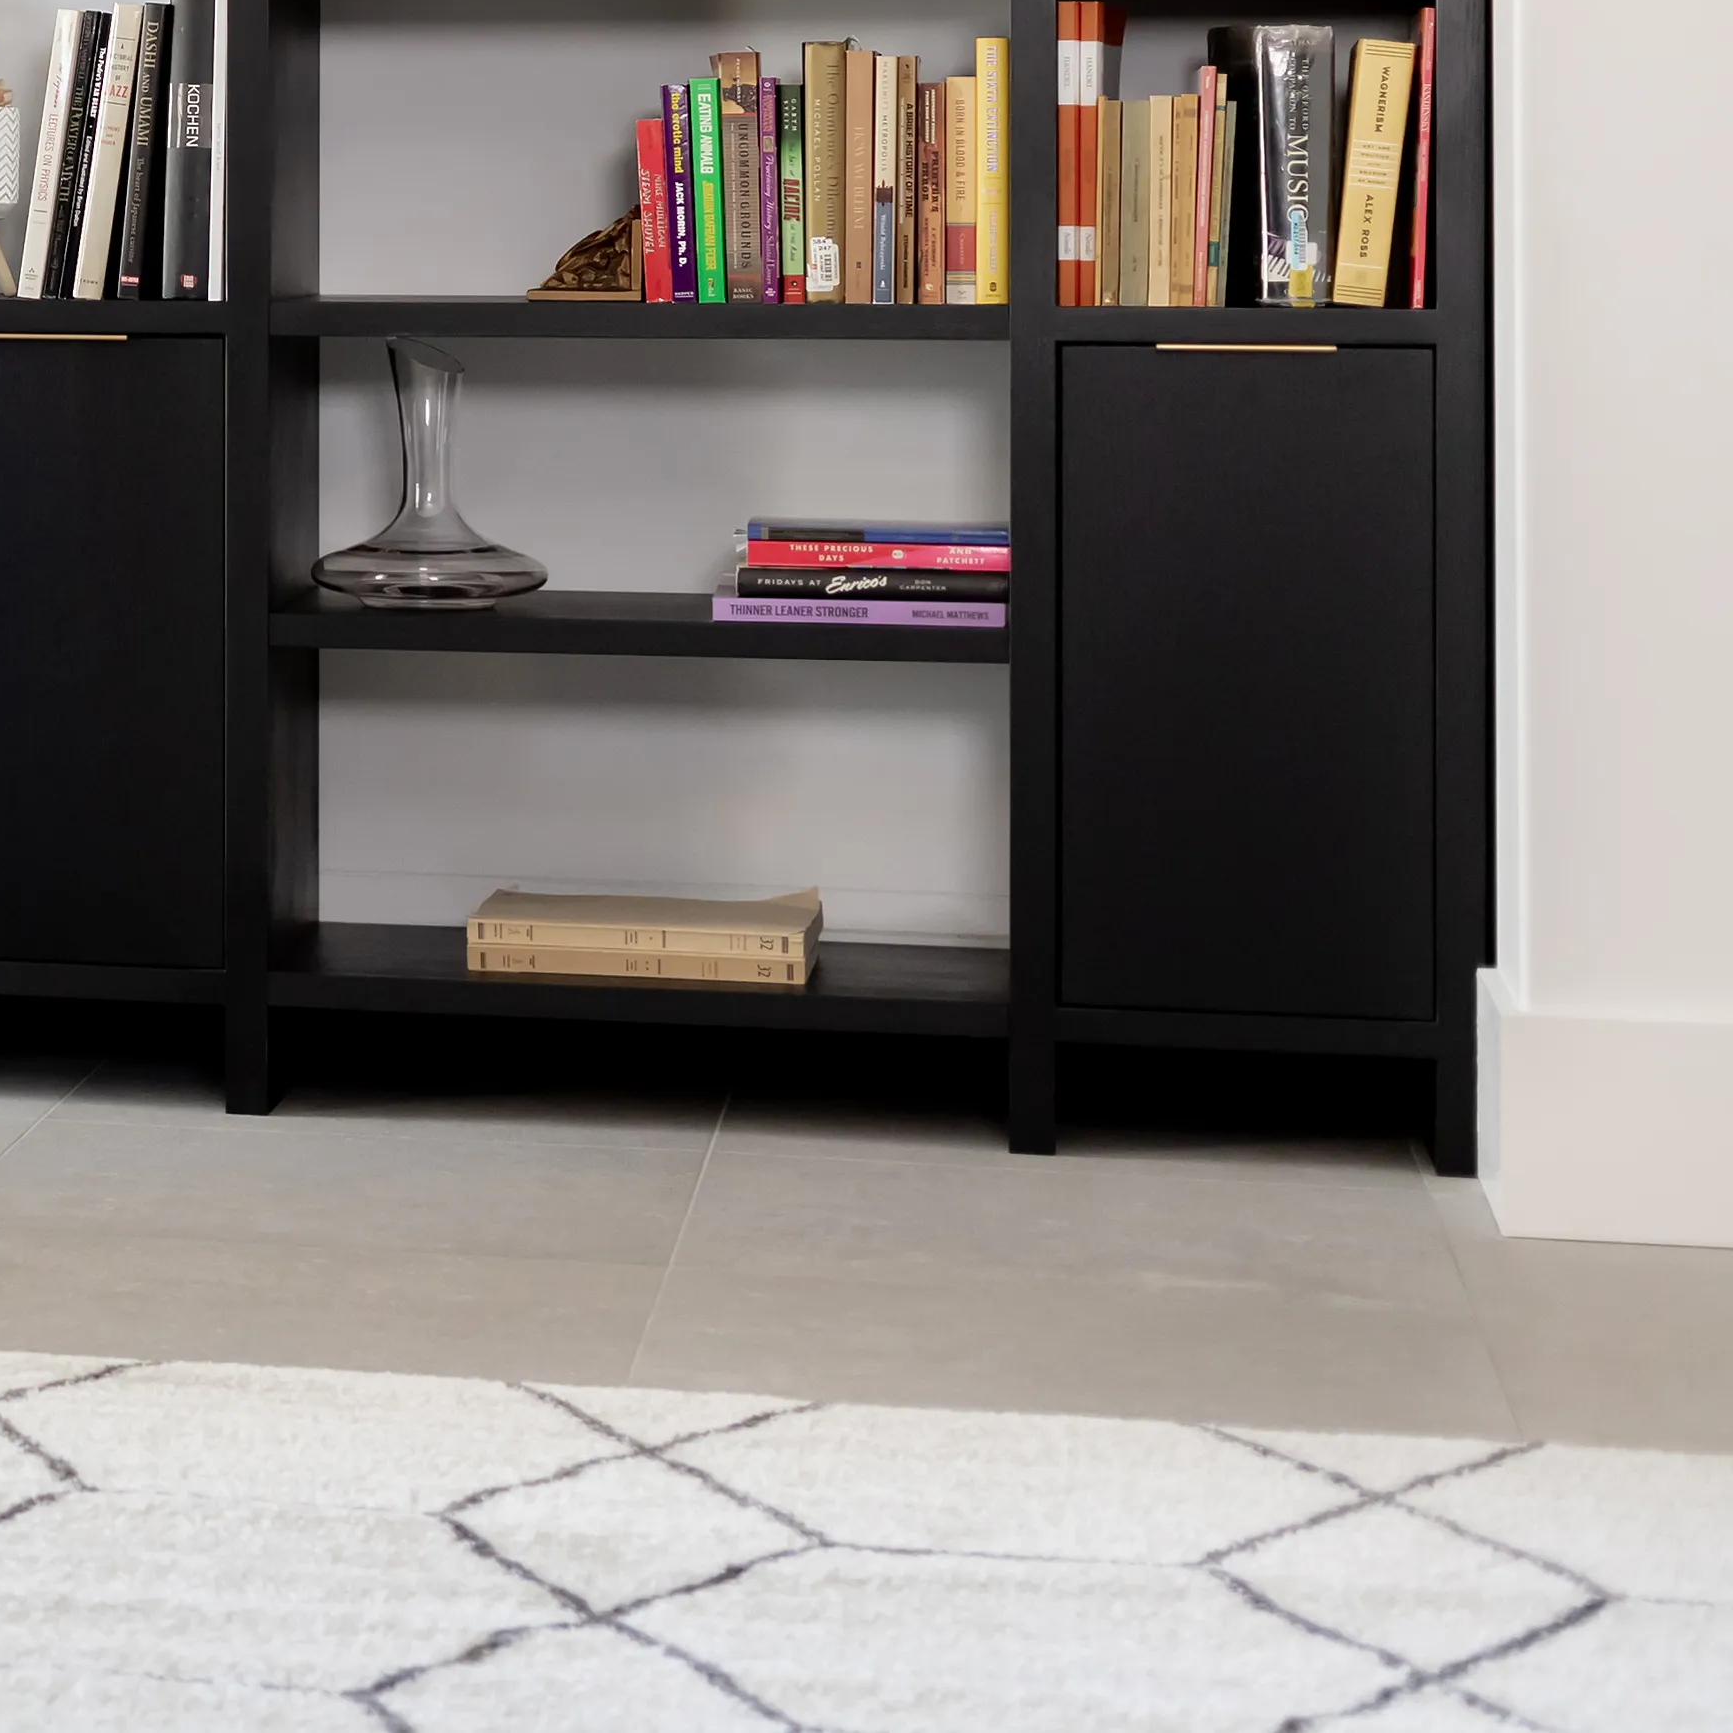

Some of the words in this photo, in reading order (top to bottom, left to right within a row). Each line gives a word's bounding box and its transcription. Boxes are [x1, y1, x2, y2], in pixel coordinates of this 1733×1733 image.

[986, 45, 998, 66] THE
[986, 70, 998, 103] SIXTH
[1374, 66, 1391, 133] WAGNERISM
[185, 83, 201, 148] KOCHEN
[698, 93, 712, 132] EATING
[813, 98, 821, 150] MICHAEL
[43, 113, 58, 152] LECTURES
[986, 107, 998, 173] EXTINCTION
[42, 154, 53, 167] ON
[699, 134, 714, 175] ANIMALS
[37, 168, 51, 202] PHYSICS
[1363, 194, 1374, 225] ALEX
[1359, 229, 1370, 258] ROSS
[819, 554, 845, 562] DAYS
[823, 545, 874, 553] PRECIOUS
[826, 575, 888, 594] Enrico's
[730, 605, 774, 616] THINNER
[775, 606, 814, 617] LEANER
[815, 607, 869, 618] STRONGER
[759, 936, 774, 951] 32
[757, 963, 771, 978] 32
